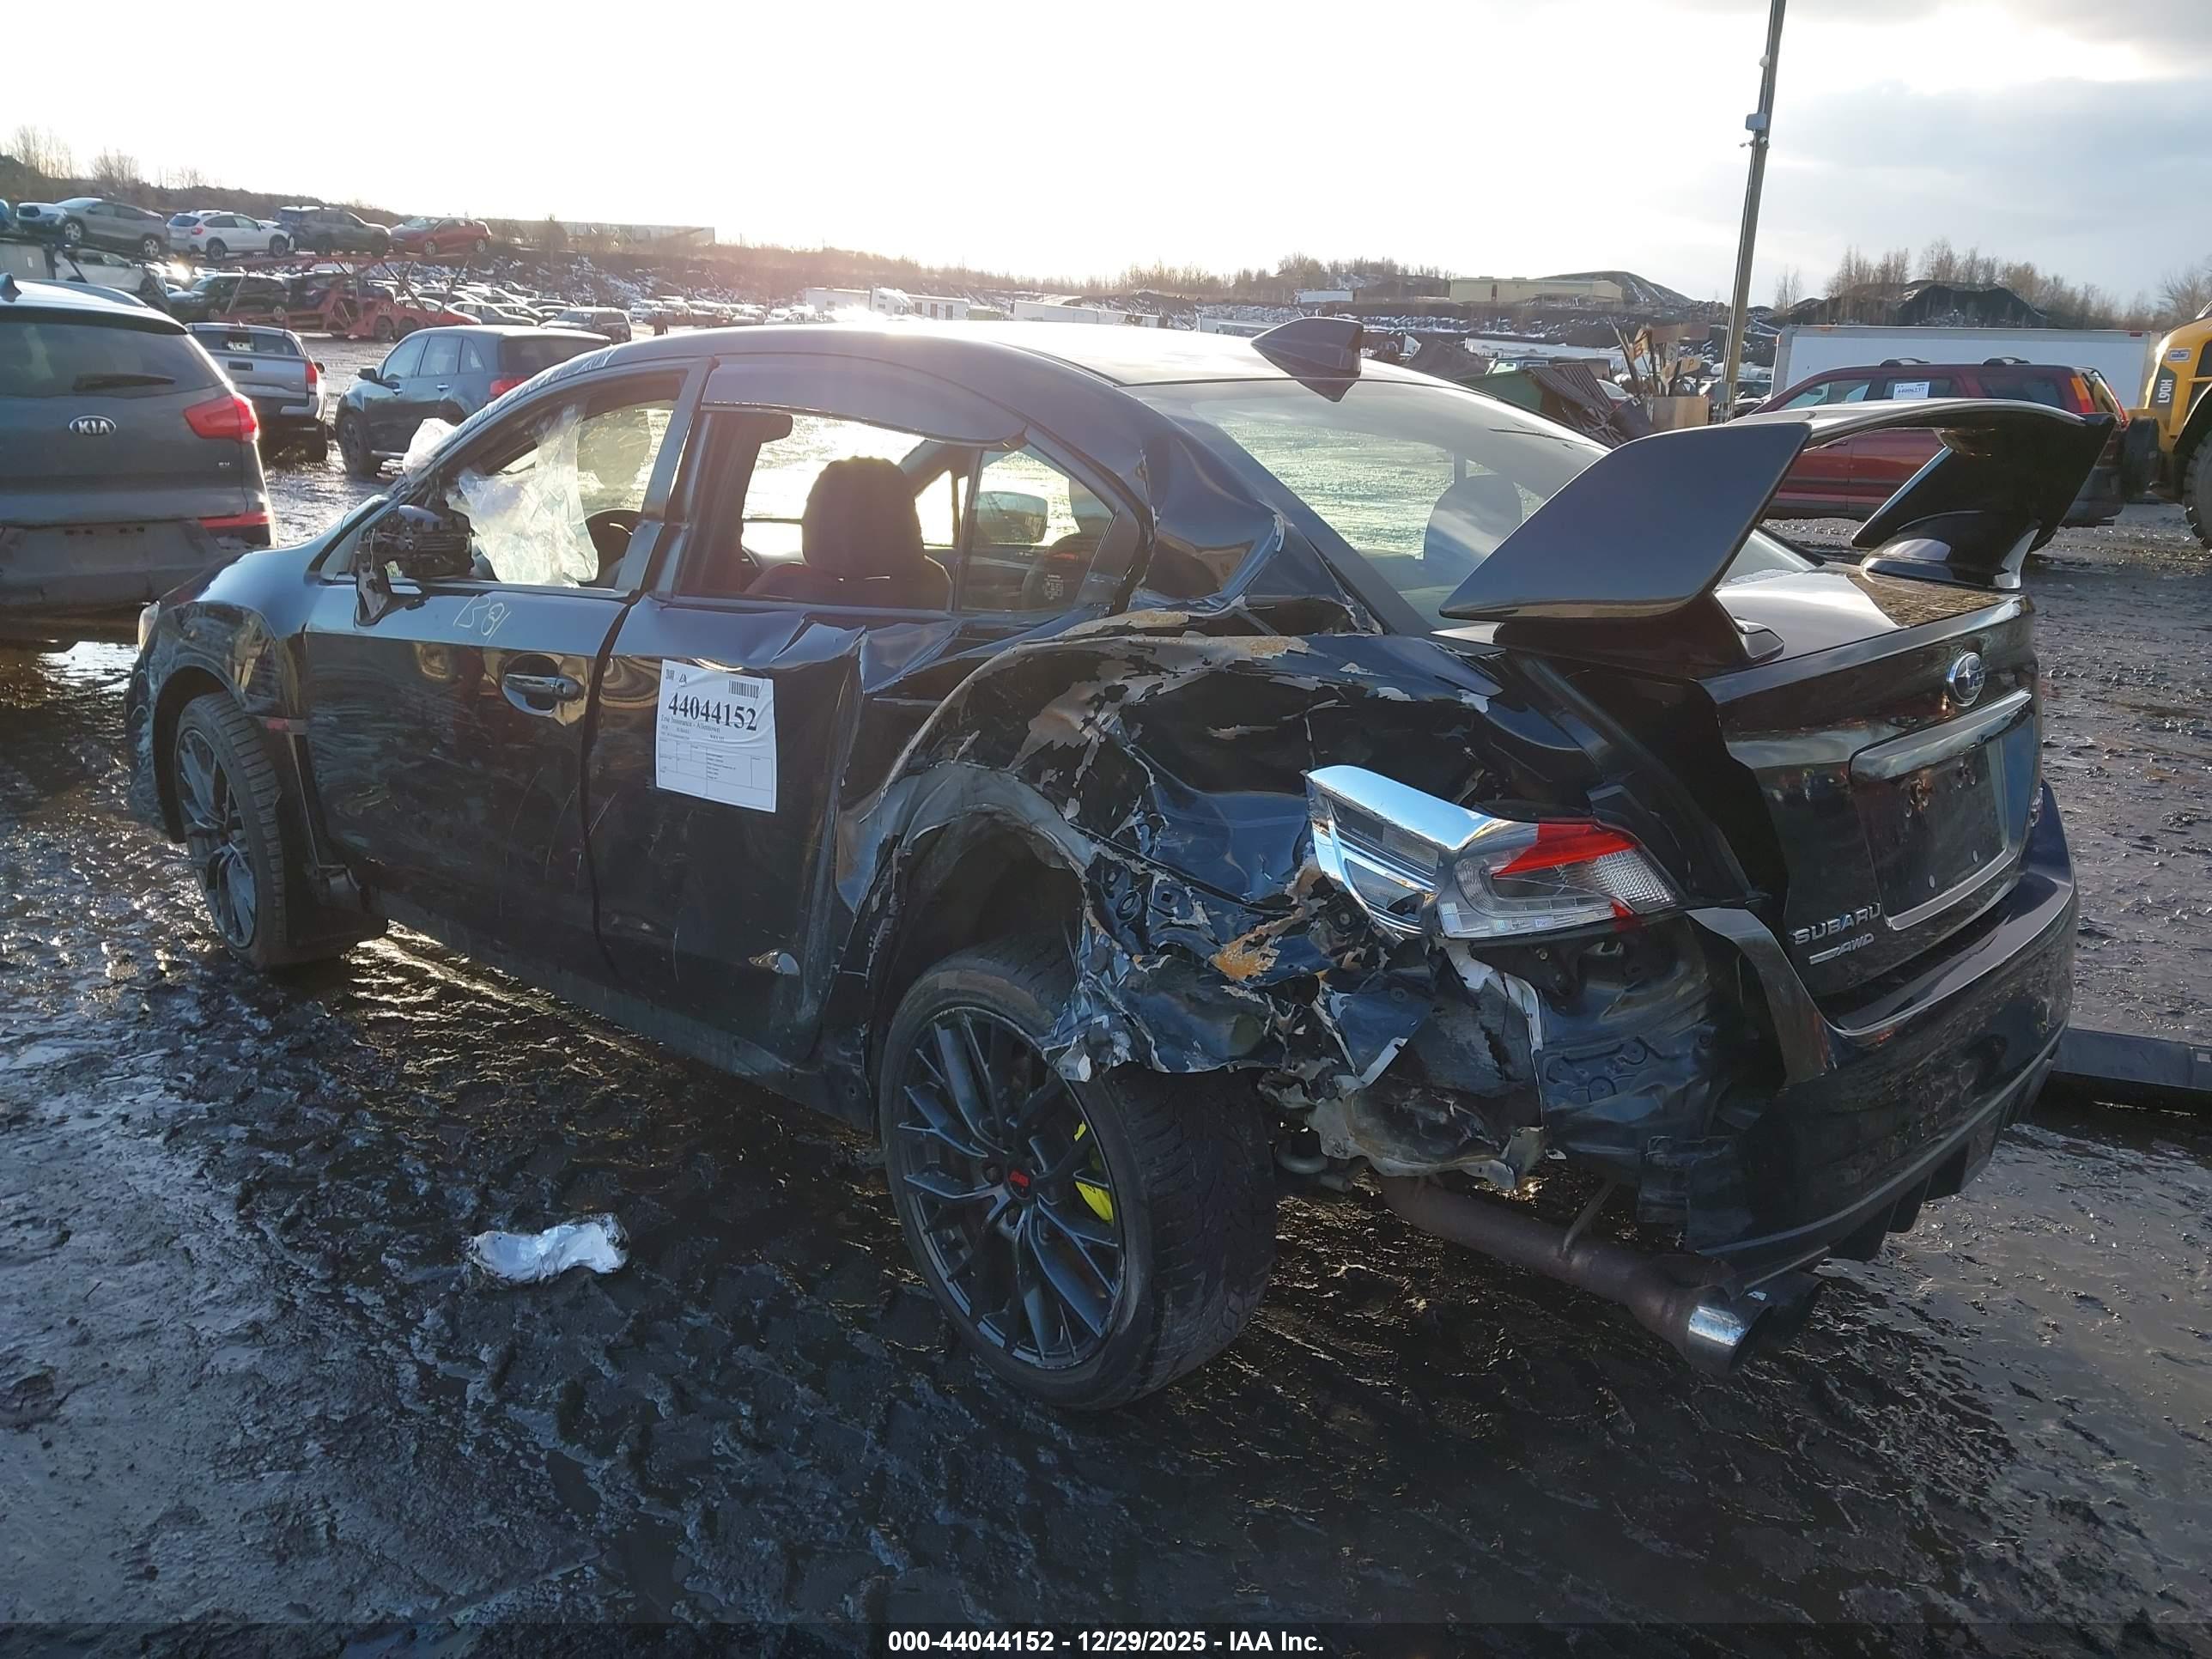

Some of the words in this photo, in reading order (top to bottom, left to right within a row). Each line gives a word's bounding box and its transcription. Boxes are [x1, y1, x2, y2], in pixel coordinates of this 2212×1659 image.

[2157, 379, 2173, 404] L90H
[77, 420, 111, 434] KIA
[668, 692, 757, 732] 44044152
[1792, 902, 1881, 945] SUBARU
